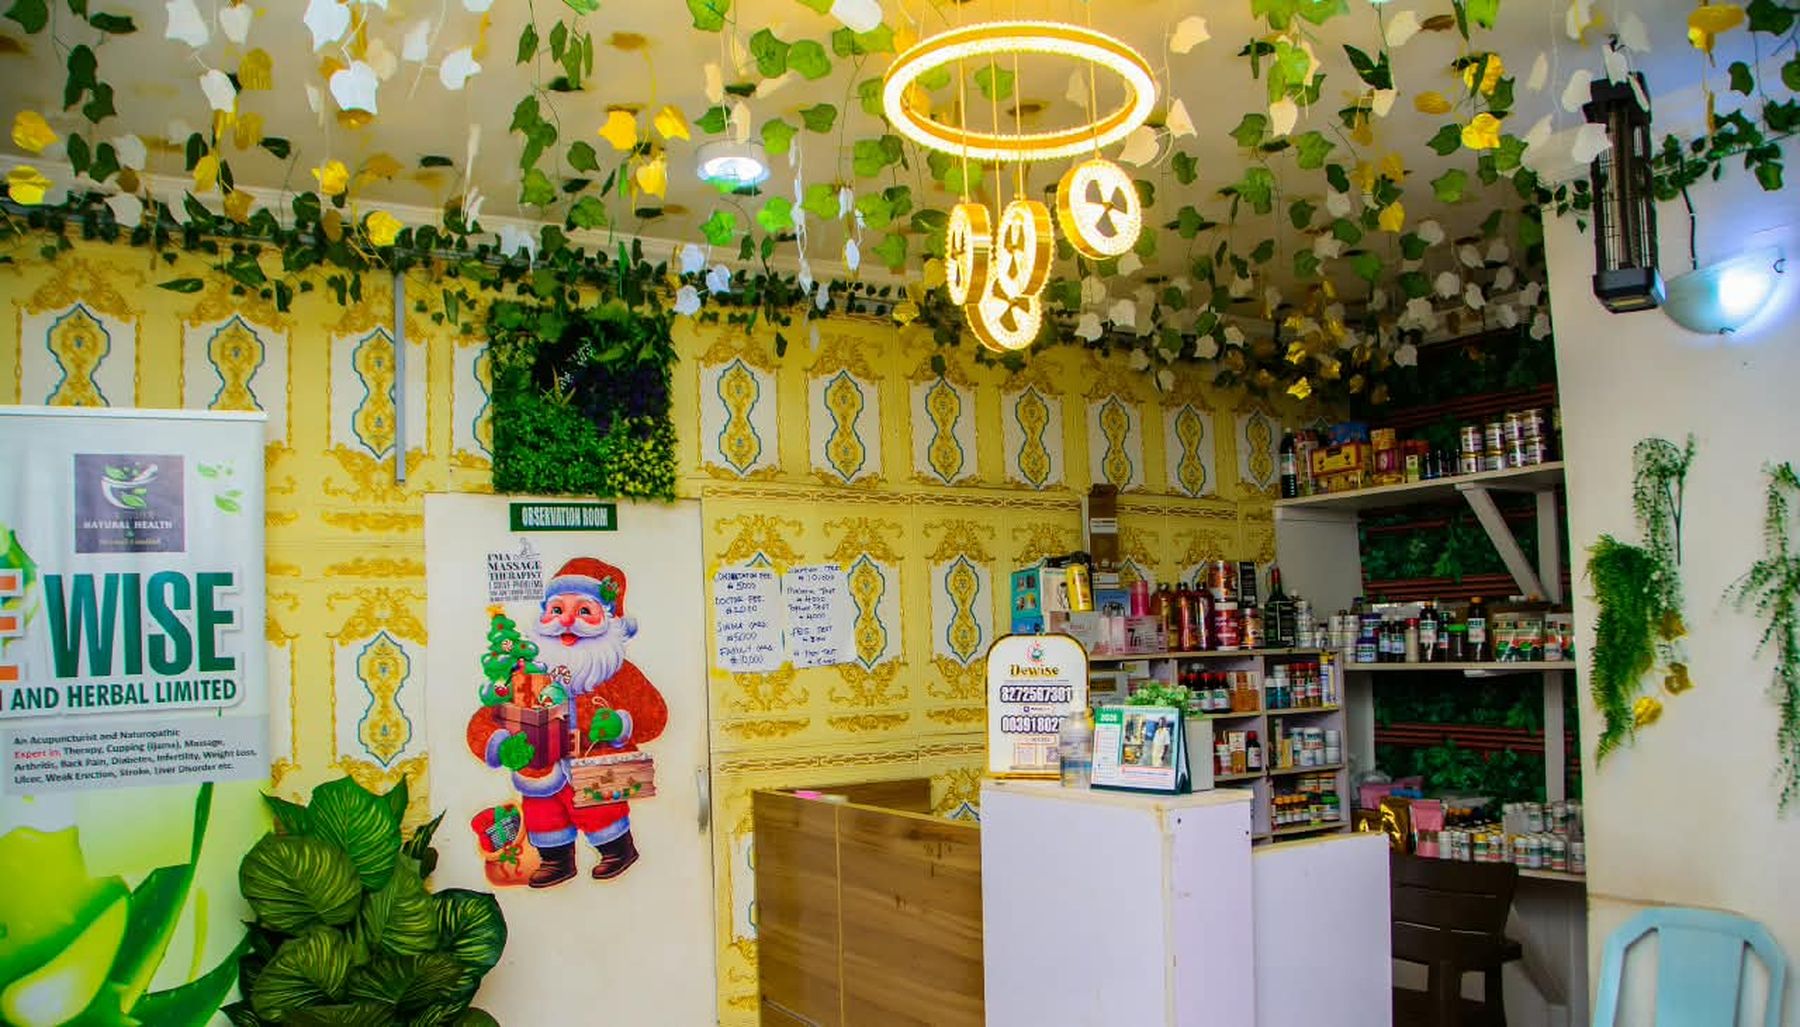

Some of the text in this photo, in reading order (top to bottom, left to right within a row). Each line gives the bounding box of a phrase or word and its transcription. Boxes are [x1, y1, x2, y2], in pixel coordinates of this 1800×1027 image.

[83, 519, 172, 529] NATURAL HEALTH
[522, 506, 608, 527] OBSERVATION ROOM
[488, 560, 543, 571] MASSAGE
[489, 571, 542, 580] THERAPIST
[44, 571, 236, 678] WISE
[1010, 664, 1060, 677] Dewise
[10, 686, 59, 711] AND
[67, 682, 149, 708] HERBAL
[155, 678, 237, 703] LIMITED
[30, 733, 98, 745] Acupuncturist
[100, 732, 118, 740] and
[120, 729, 180, 739] Naturopathic
[14, 750, 47, 760] Expert
[106, 743, 145, 752] Cupping
[61, 759, 82, 768] Back
[202, 750, 234, 760] Weight
[45, 773, 73, 783] Weak
[154, 765, 176, 775] Liver
[178, 763, 216, 774] Disorder
